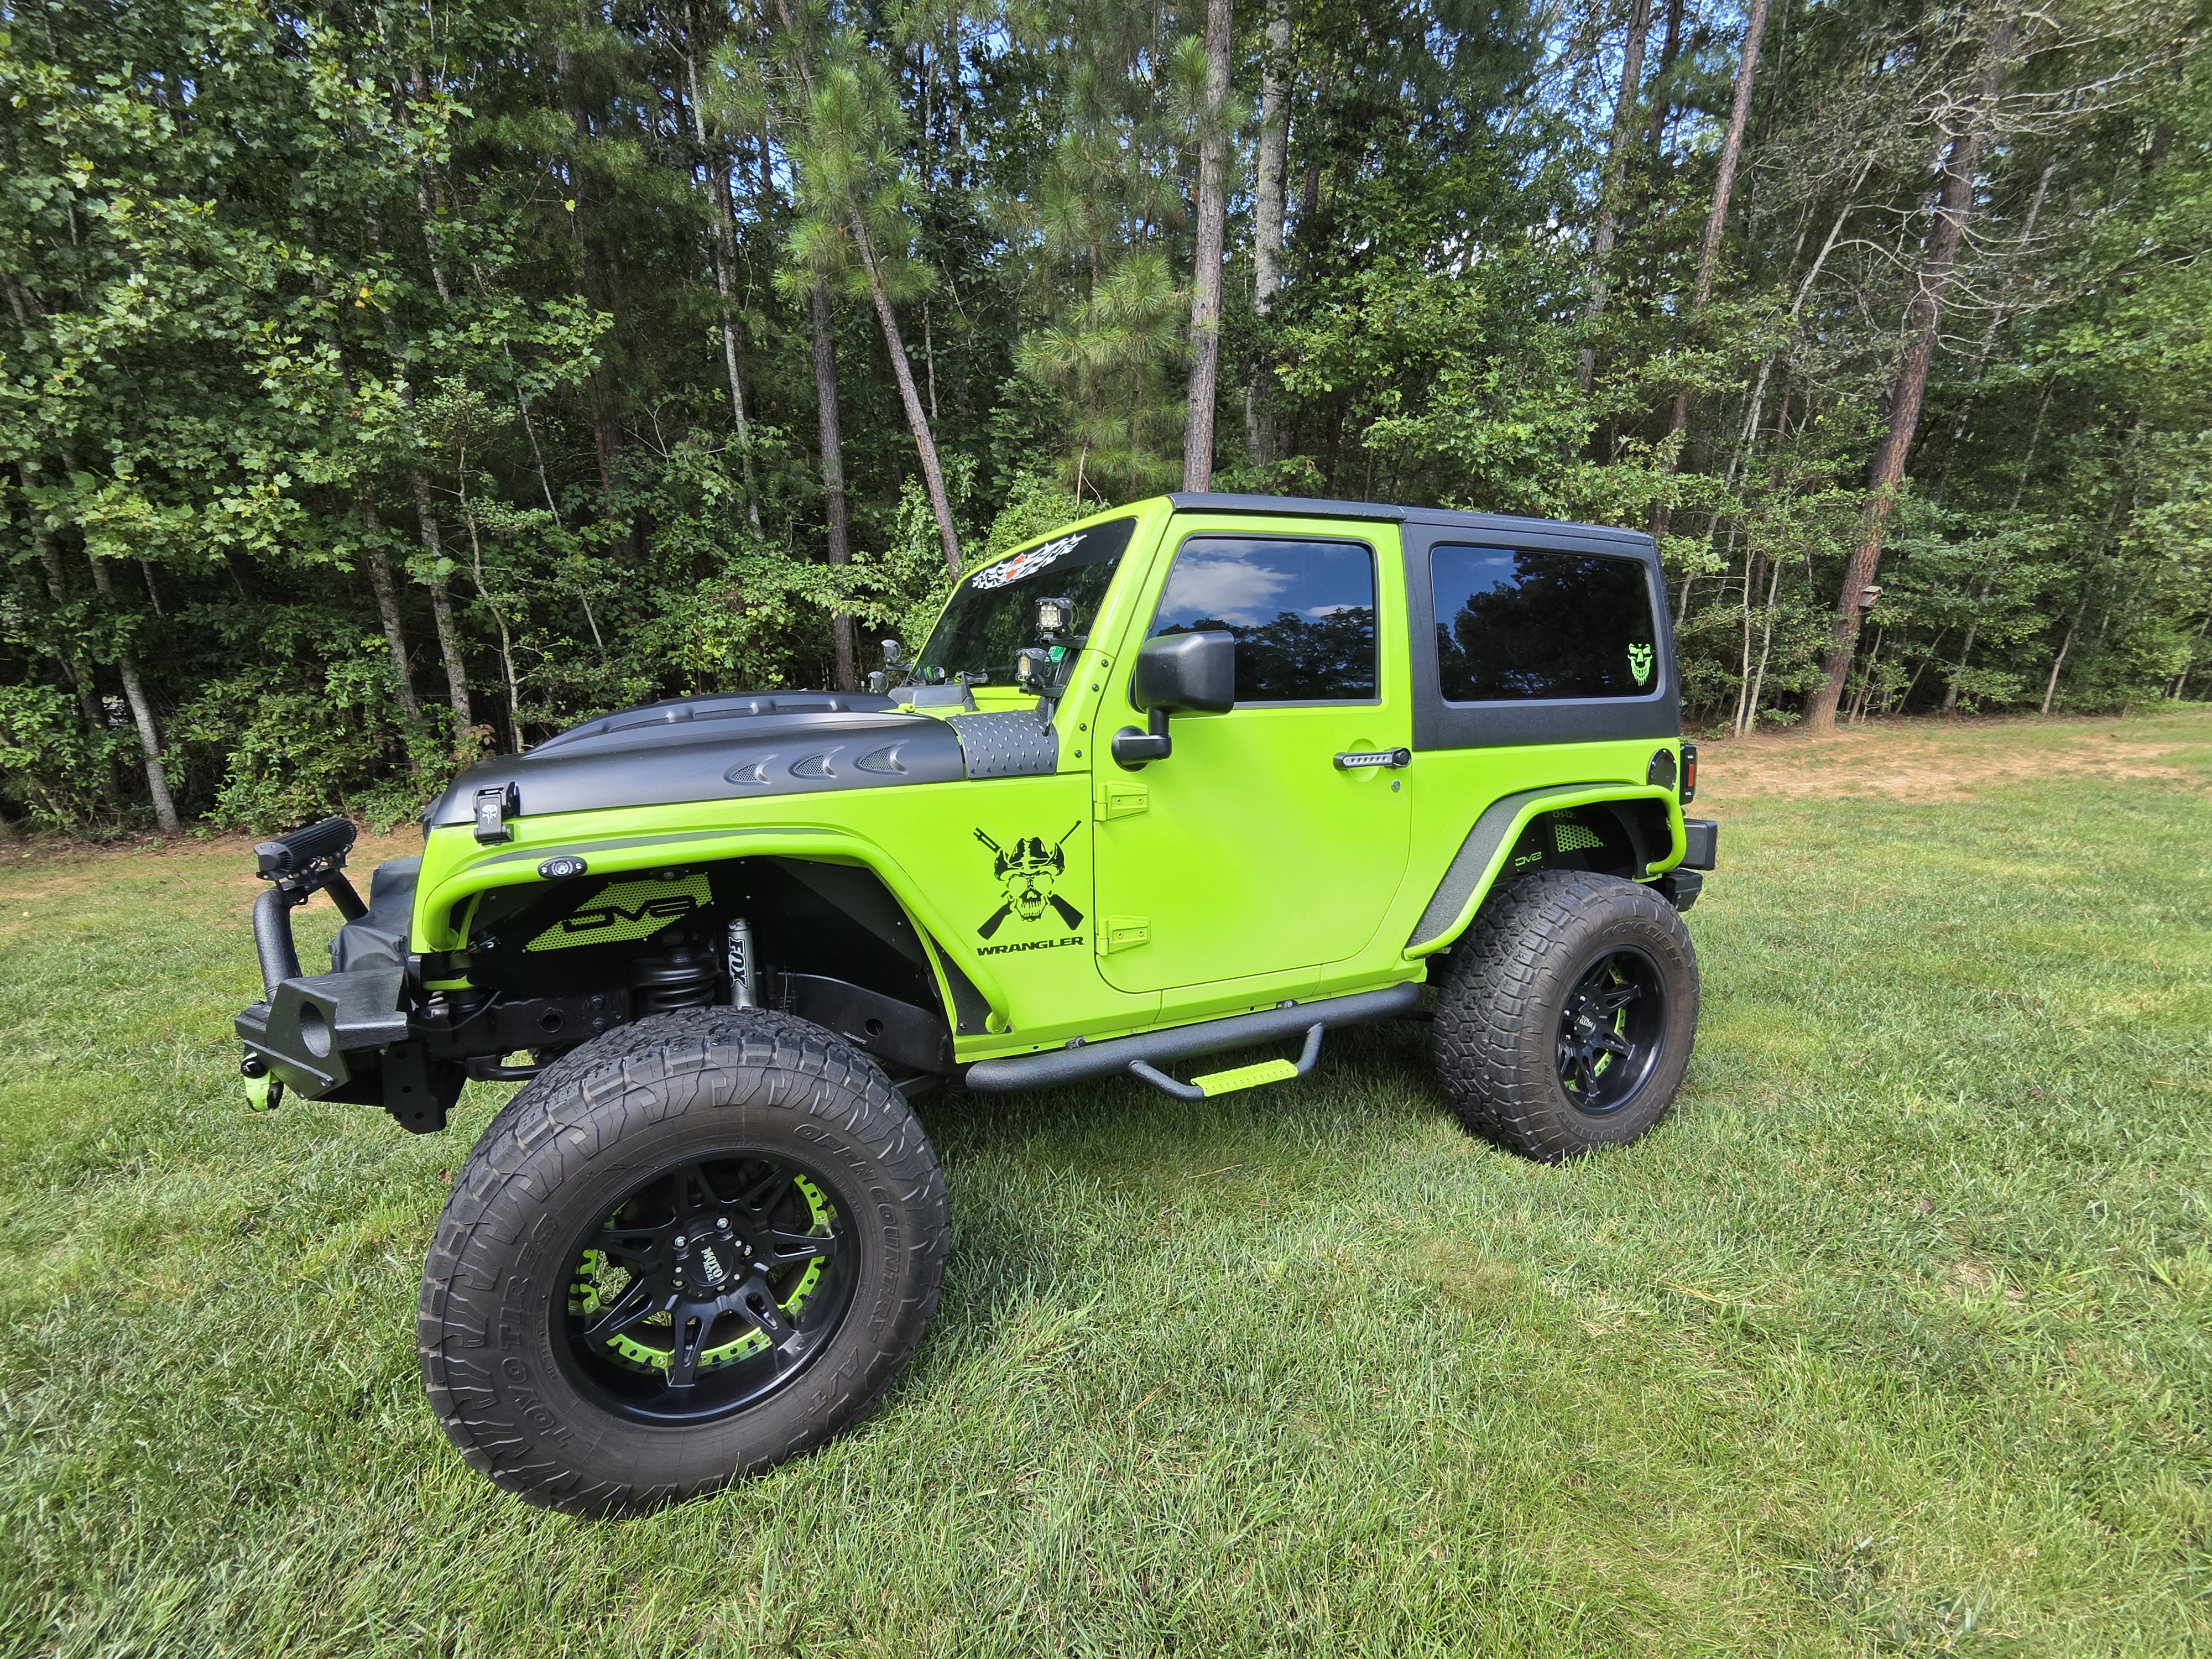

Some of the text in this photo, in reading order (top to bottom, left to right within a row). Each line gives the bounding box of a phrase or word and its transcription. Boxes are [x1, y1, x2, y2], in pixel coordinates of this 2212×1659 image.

[728, 936, 748, 989] FOX
[977, 936, 1085, 956] WRANGLER
[1602, 921, 1683, 969] TOYO TIRES
[1556, 1110, 1621, 1141] COUNTRY
[794, 1123, 878, 1182] OPEN
[701, 1246, 723, 1278] MOTO
[867, 1186, 901, 1343] COUNTRY
[499, 1212, 575, 1449] TOYO TIRES
[808, 1346, 860, 1417] A/T
